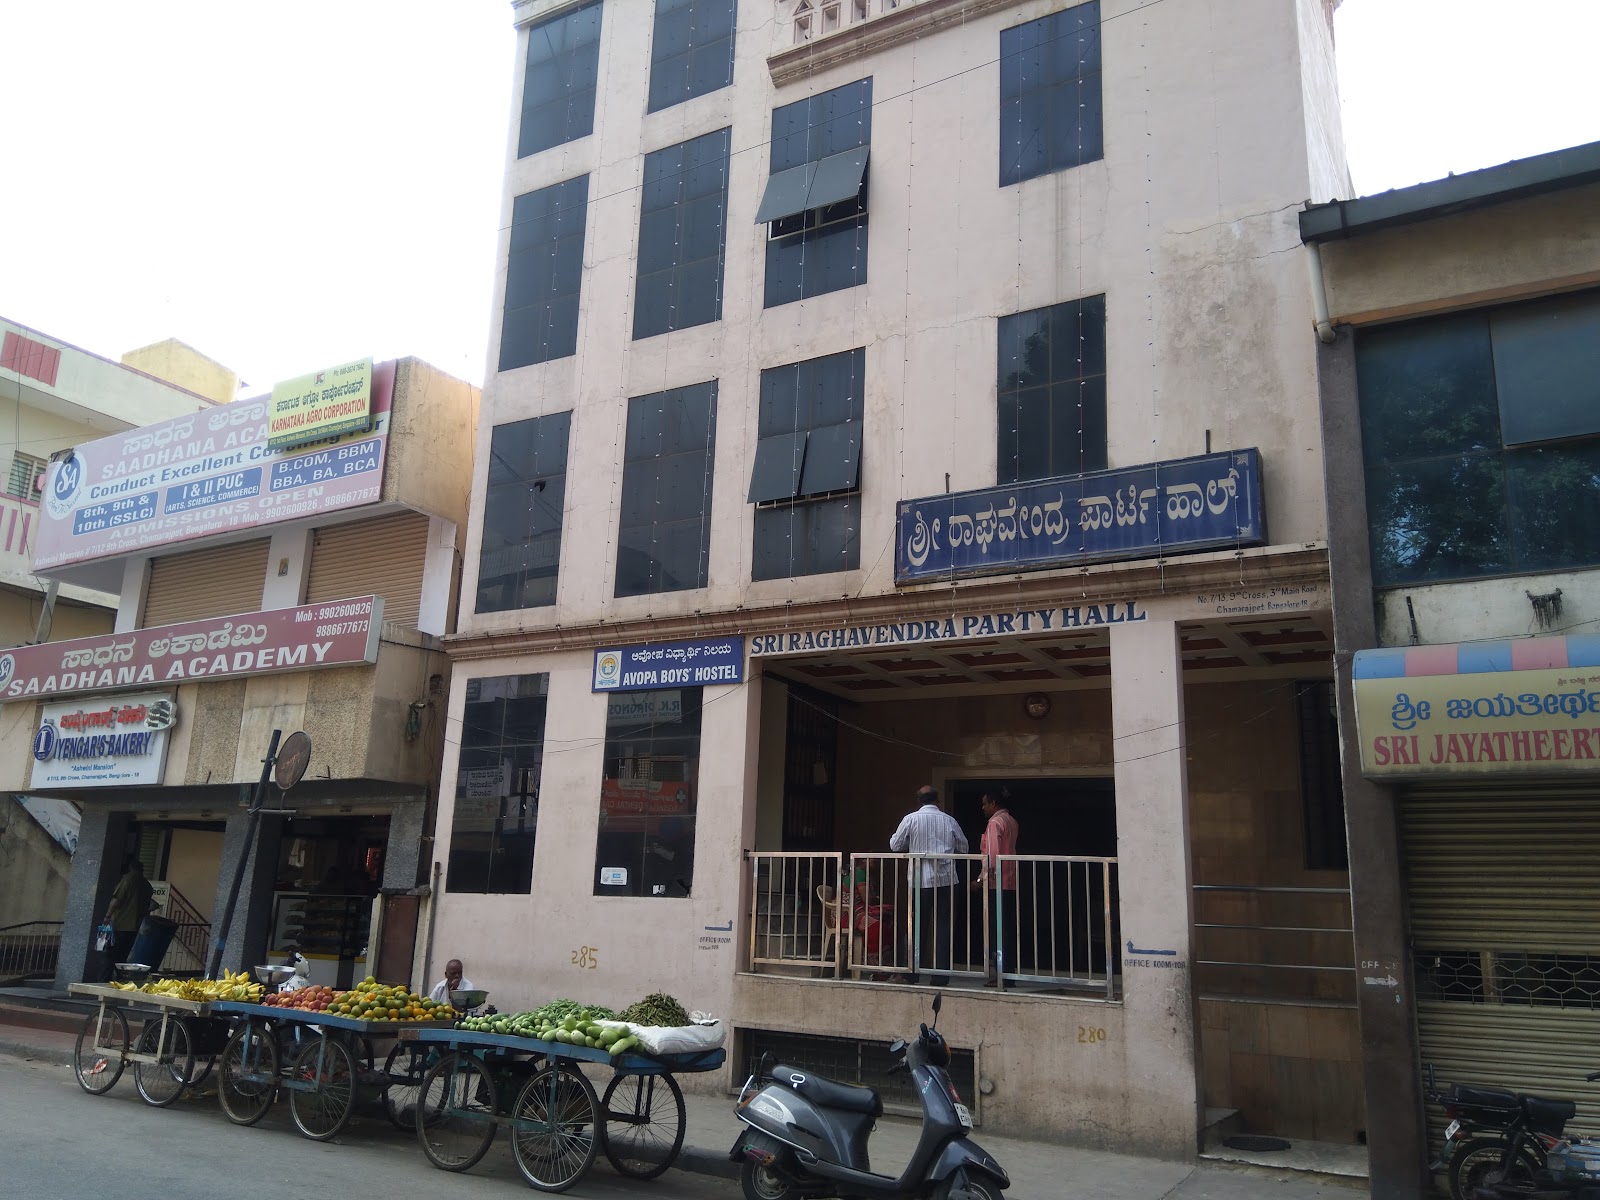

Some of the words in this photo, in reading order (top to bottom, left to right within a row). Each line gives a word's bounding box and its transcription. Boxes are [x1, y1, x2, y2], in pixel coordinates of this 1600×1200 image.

[271, 412, 305, 432] KARNATAKA
[306, 408, 322, 424] AGRO
[323, 397, 367, 420] CORPORATION
[122, 415, 195, 455] ಸಾಧನ
[101, 437, 215, 480] SAADHANA
[223, 423, 269, 448] ACA
[279, 453, 332, 474] B.COM,
[338, 443, 374, 460] BBM
[91, 473, 155, 499] Conduct
[161, 451, 243, 482] Excellent
[182, 486, 188, 499] I
[191, 483, 201, 497] &
[204, 480, 213, 494] II
[216, 473, 244, 491] PUC
[273, 475, 307, 489] BBA,
[312, 466, 337, 481] BA,
[343, 457, 376, 474] BCA
[84, 507, 108, 519] 8th,
[112, 500, 134, 512] 9th
[138, 494, 150, 505] &
[217, 485, 259, 502] COMMERCE)
[78, 518, 105, 533] 10th
[110, 508, 154, 526] (SSLC)
[109, 502, 251, 540] ADMISSIONS
[258, 486, 325, 508] OPEN
[185, 520, 222, 535] Bengaluru
[229, 515, 238, 526] 18
[266, 502, 317, 519] 9902600926
[325, 486, 380, 507] 9886677673
[907, 510, 941, 567] ಶ್ರೀ
[948, 491, 1070, 554] ರಾಘವೇಂದ್ರ
[1166, 468, 1240, 521] ಹಾಲ್
[1242, 590, 1269, 600] Cross,
[1281, 586, 1300, 596] Main
[1301, 584, 1318, 593] Road
[295, 611, 312, 623] Mob
[319, 601, 371, 620] 9902600926
[1216, 603, 1265, 614] Chamarajpet
[316, 620, 368, 638] 9886677673
[751, 633, 784, 656] SRI
[788, 617, 957, 652] RAGHAVENDRA
[962, 608, 1057, 637] PARTY
[1061, 601, 1147, 628] HALL
[61, 636, 137, 669] ಸಾಧನ
[148, 622, 267, 658] ಅಕಾಡೆಮಿ
[703, 643, 732, 656] ನಿಲಯ
[7, 663, 155, 697] SAADHANA
[165, 641, 333, 680] ACADEMY
[622, 671, 658, 686] AVOPA
[660, 667, 692, 683] BOYS'
[694, 664, 738, 681] HOSTEL
[1391, 693, 1431, 730] ಶ್ರೀ
[54, 734, 106, 759] IYENGAR'S
[107, 732, 152, 756] BAKERY
[1373, 735, 1421, 766] SRI
[571, 945, 599, 969] 285
[1124, 959, 1150, 968] OFFICE
[1077, 1026, 1107, 1043] 280
